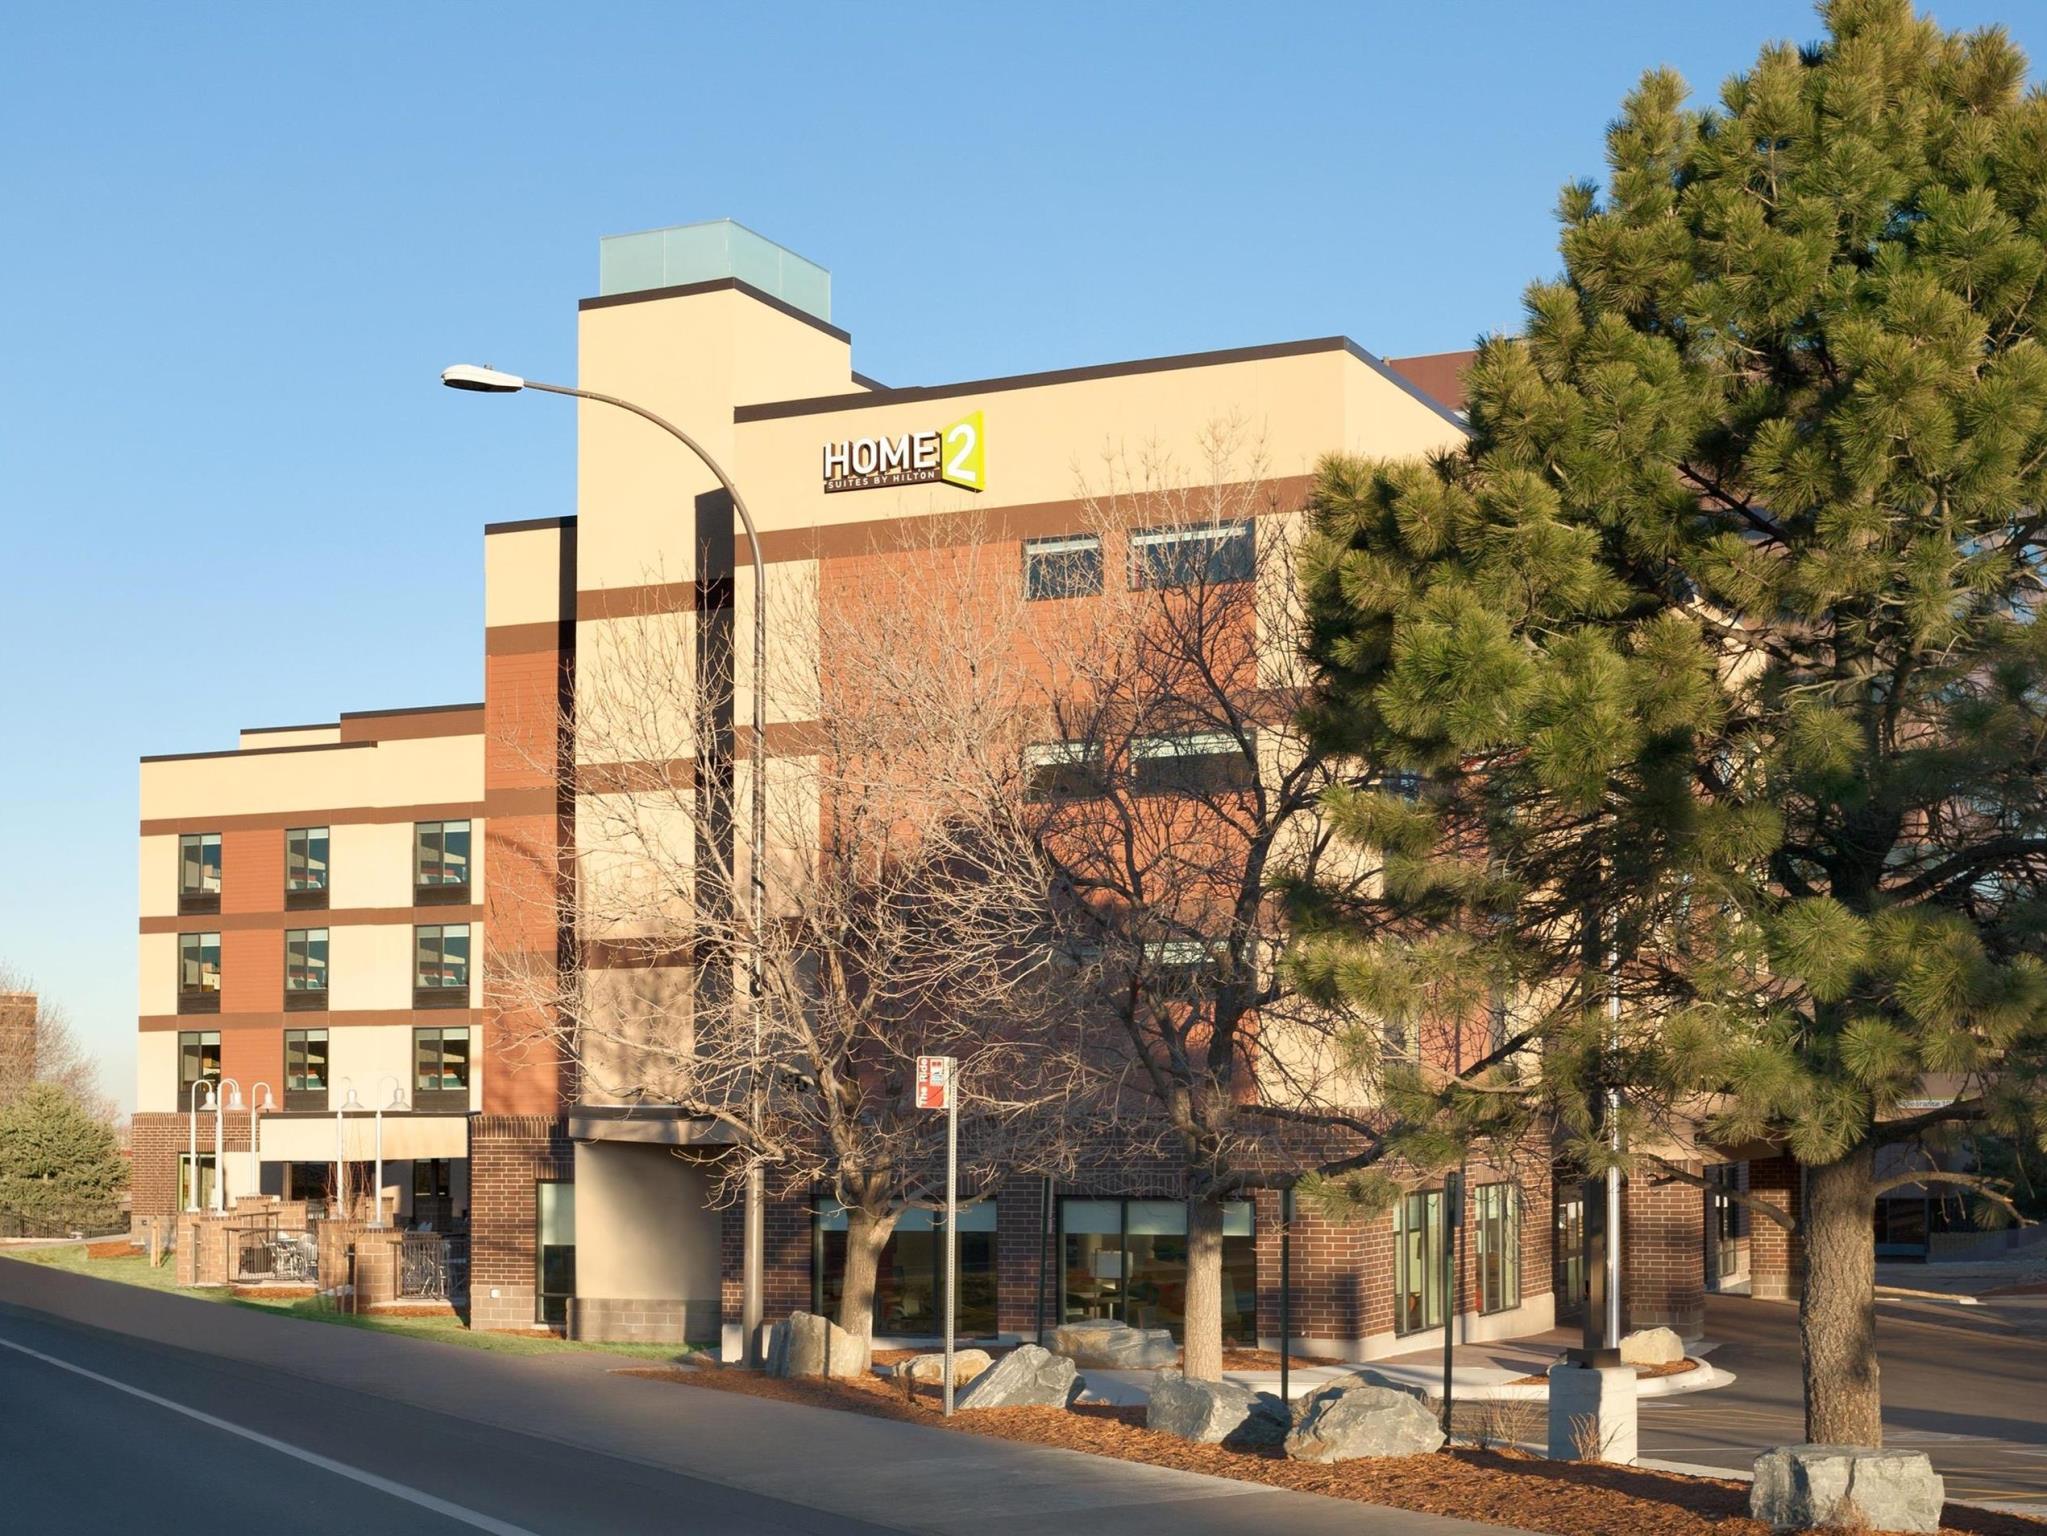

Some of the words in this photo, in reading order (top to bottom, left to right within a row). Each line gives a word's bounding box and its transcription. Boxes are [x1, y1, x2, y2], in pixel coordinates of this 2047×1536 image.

[824, 432, 936, 478] HOME
[946, 424, 976, 482] 2
[829, 478, 868, 489] SUITES
[874, 475, 887, 485] BY
[893, 470, 935, 483] HILTON
[919, 1058, 928, 1082] Ride
[919, 1086, 928, 1105] The
